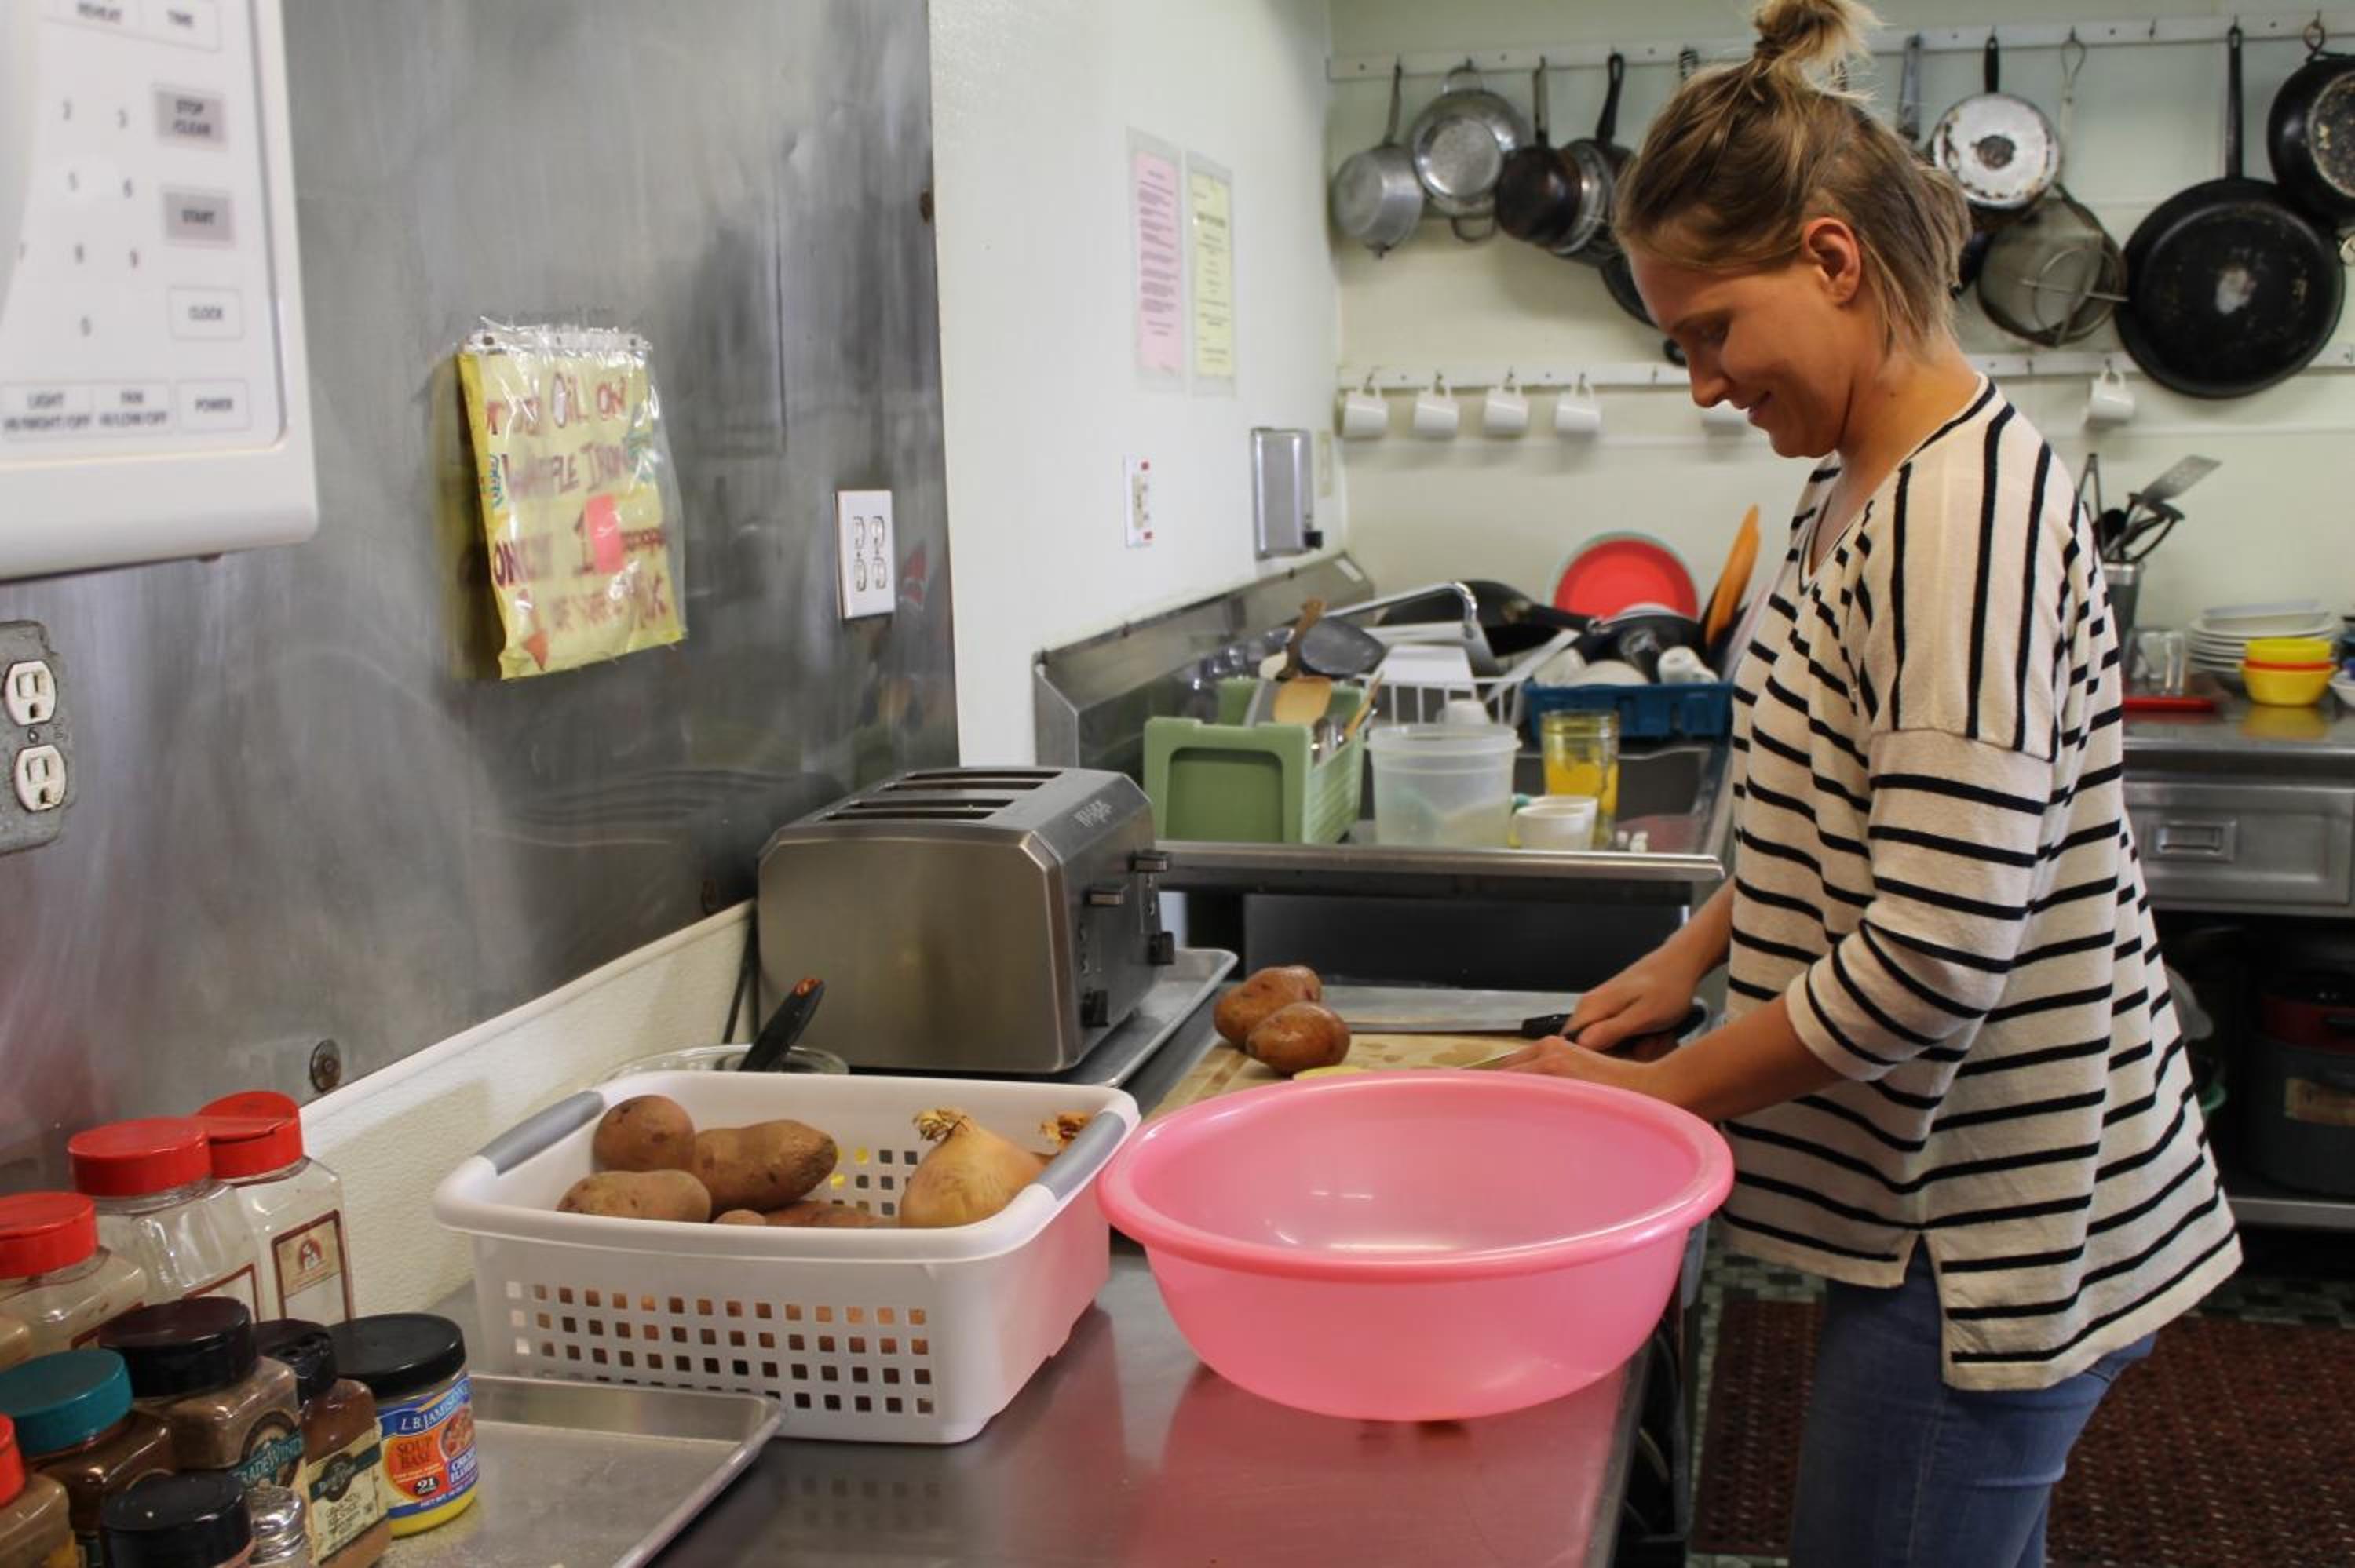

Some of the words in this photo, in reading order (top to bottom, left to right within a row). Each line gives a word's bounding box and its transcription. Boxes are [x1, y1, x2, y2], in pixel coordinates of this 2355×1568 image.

[181, 209, 215, 224] START
[188, 305, 223, 320] CLOCK
[195, 398, 233, 411] POWER
[396, 1436, 434, 1454] SOUP
[401, 1449, 429, 1469] BASE
